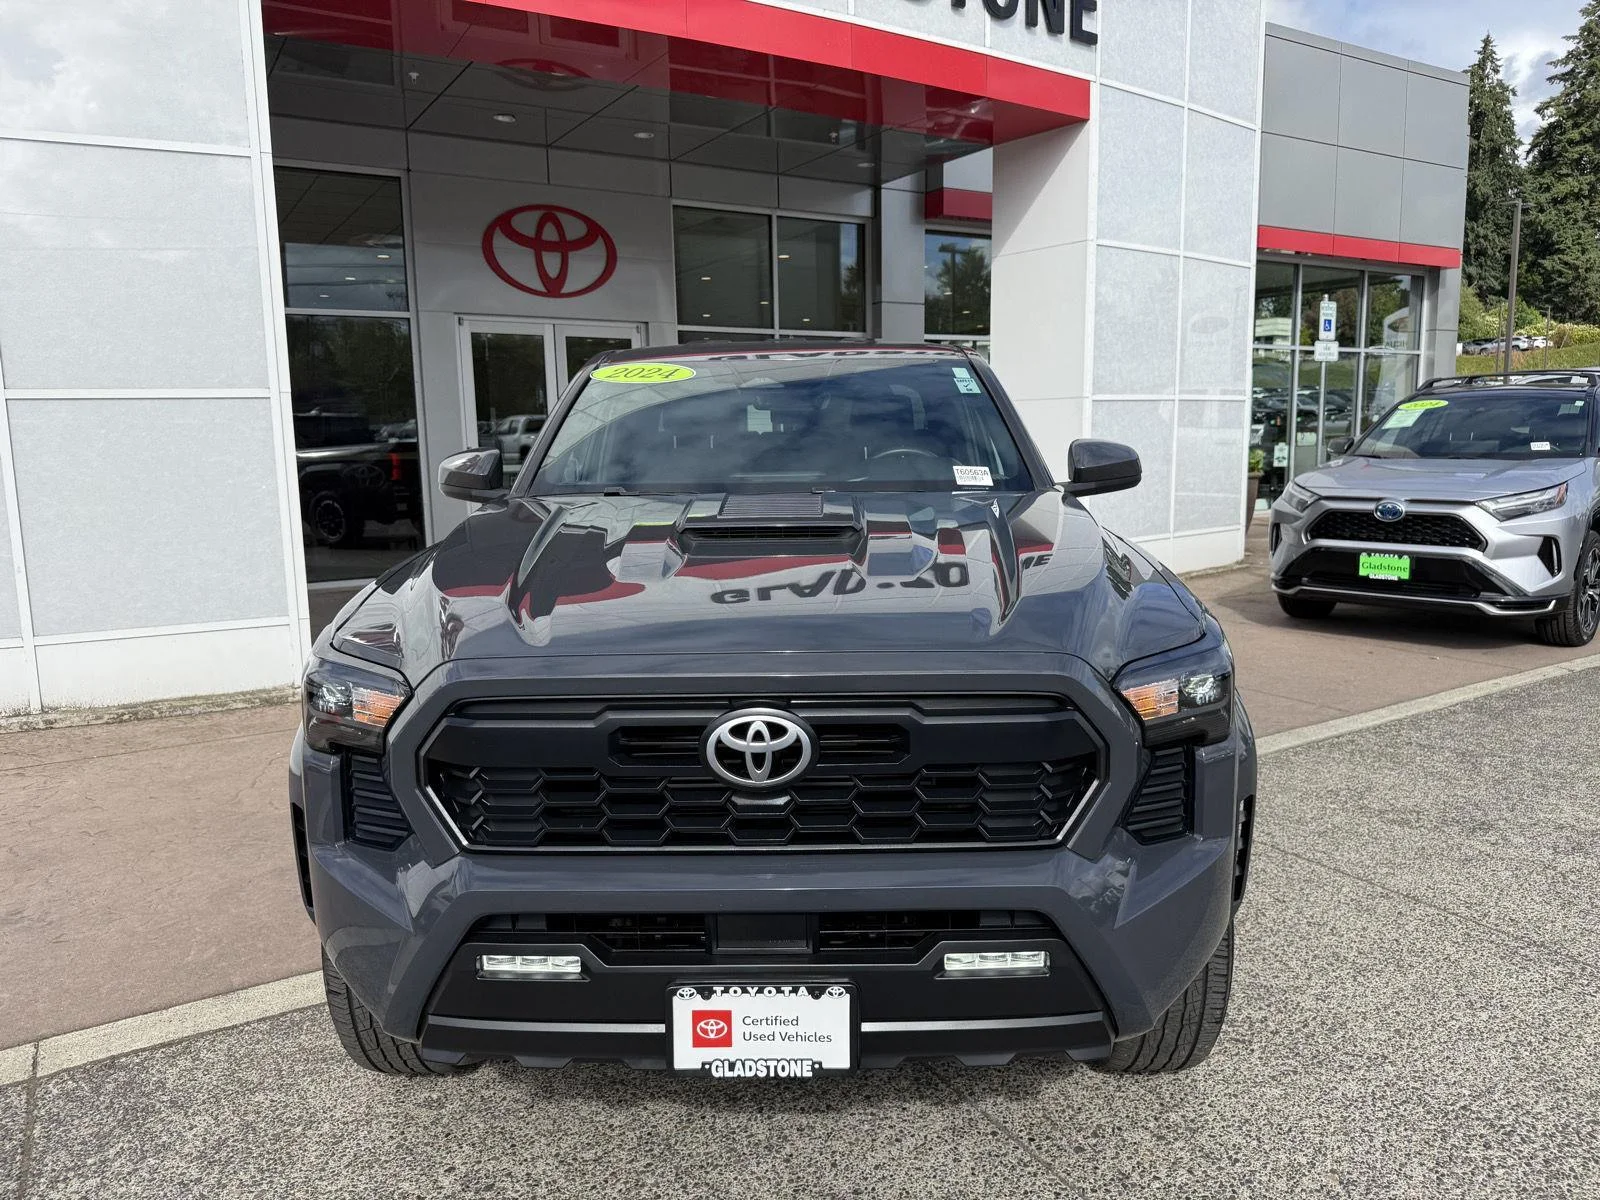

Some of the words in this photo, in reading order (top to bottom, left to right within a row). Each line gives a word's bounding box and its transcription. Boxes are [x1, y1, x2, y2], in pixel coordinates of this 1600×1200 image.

[605, 367, 681, 379] 2024
[1361, 562, 1408, 572] Gladstone
[713, 986, 809, 997] TOYOTA
[742, 1015, 799, 1026] Certified
[742, 1031, 775, 1042] Used
[779, 1031, 832, 1042] Vehicles
[711, 1059, 813, 1077] GLADSTONE
